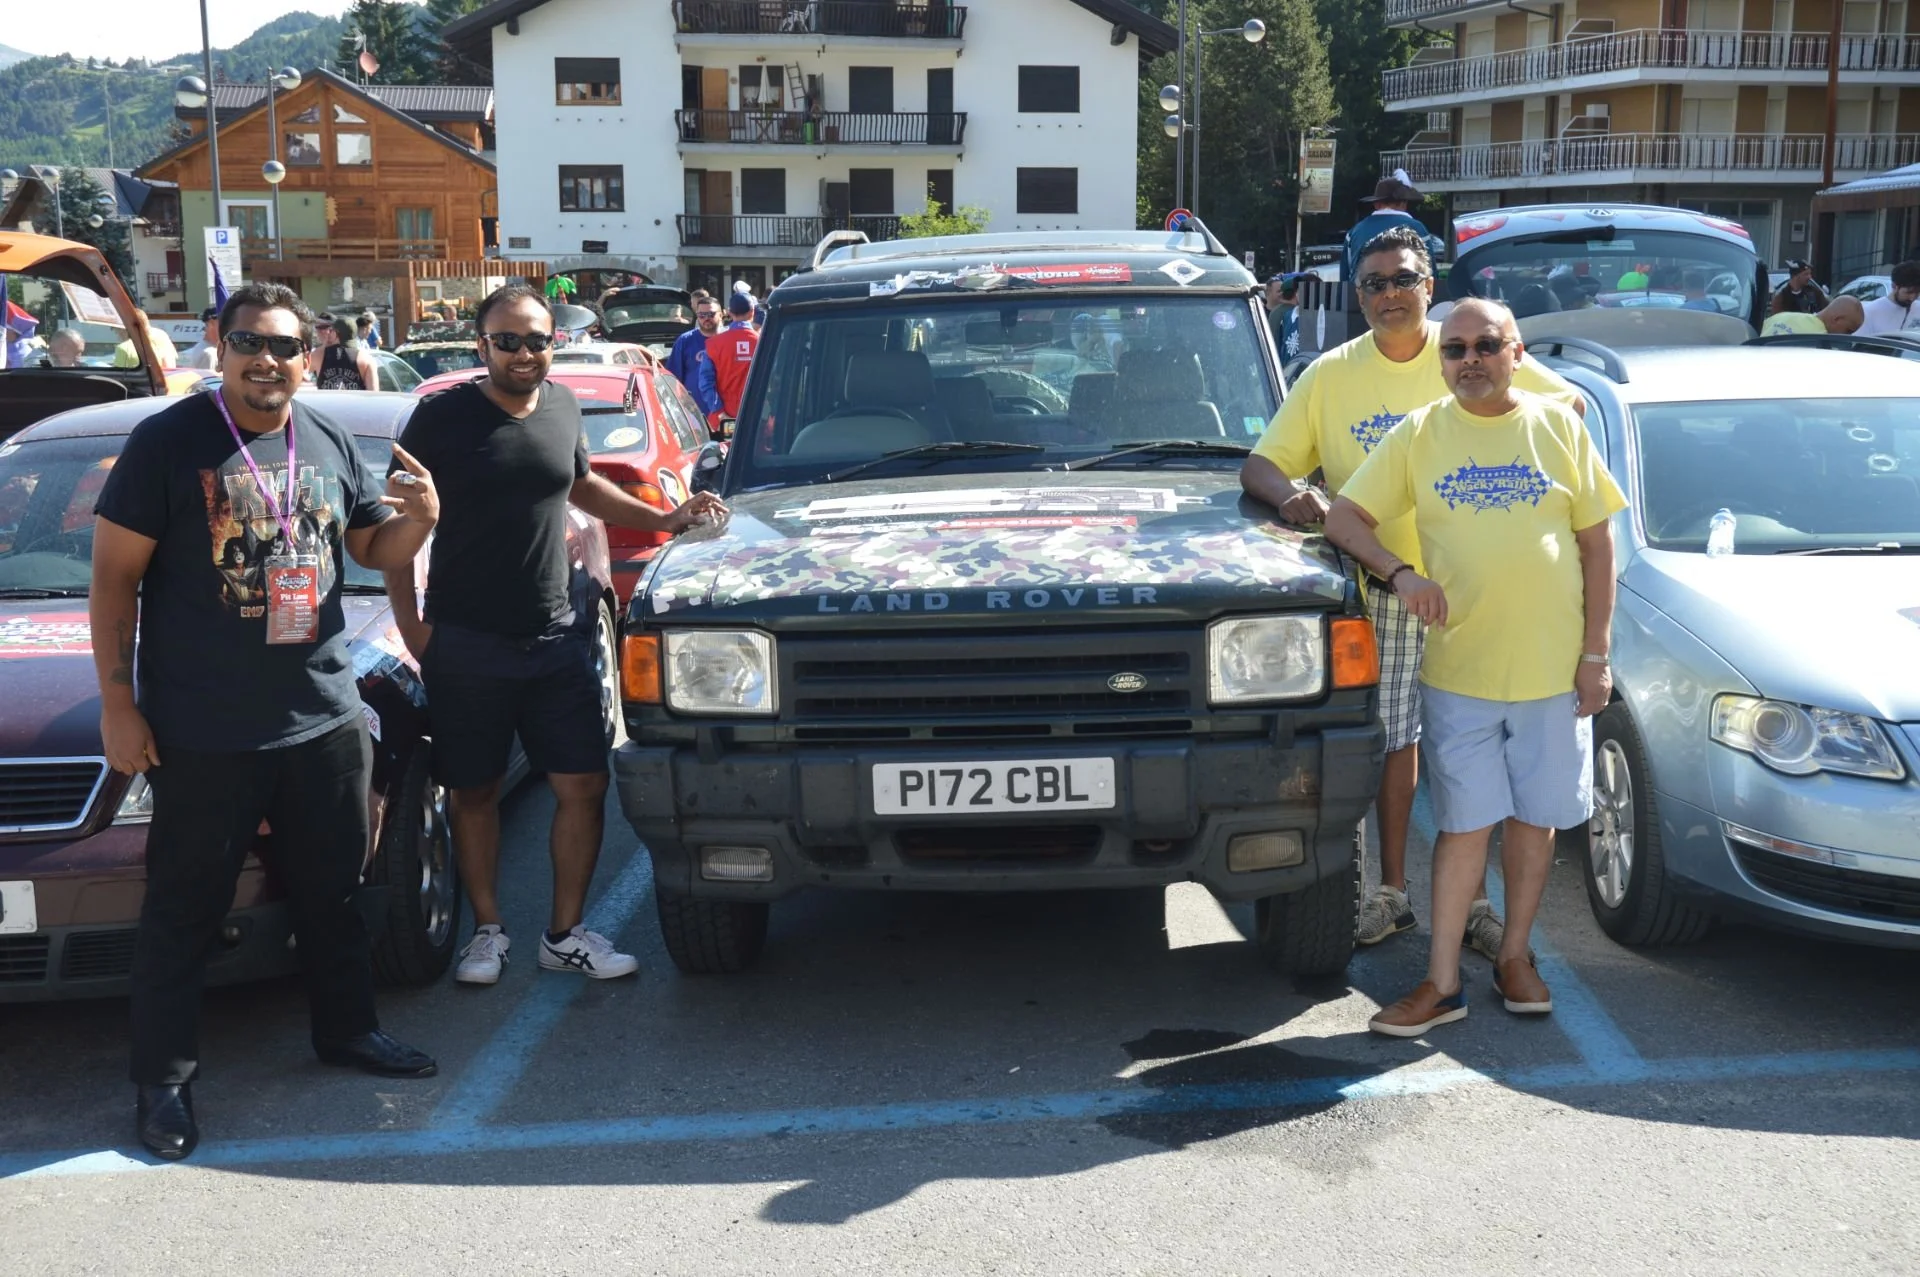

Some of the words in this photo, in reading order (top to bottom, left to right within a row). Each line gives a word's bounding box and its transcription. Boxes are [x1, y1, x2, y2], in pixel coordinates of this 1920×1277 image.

[218, 231, 226, 243] P
[818, 592, 949, 612] LAND
[987, 586, 1158, 609] ROVER
[1007, 765, 1089, 804] CBL
